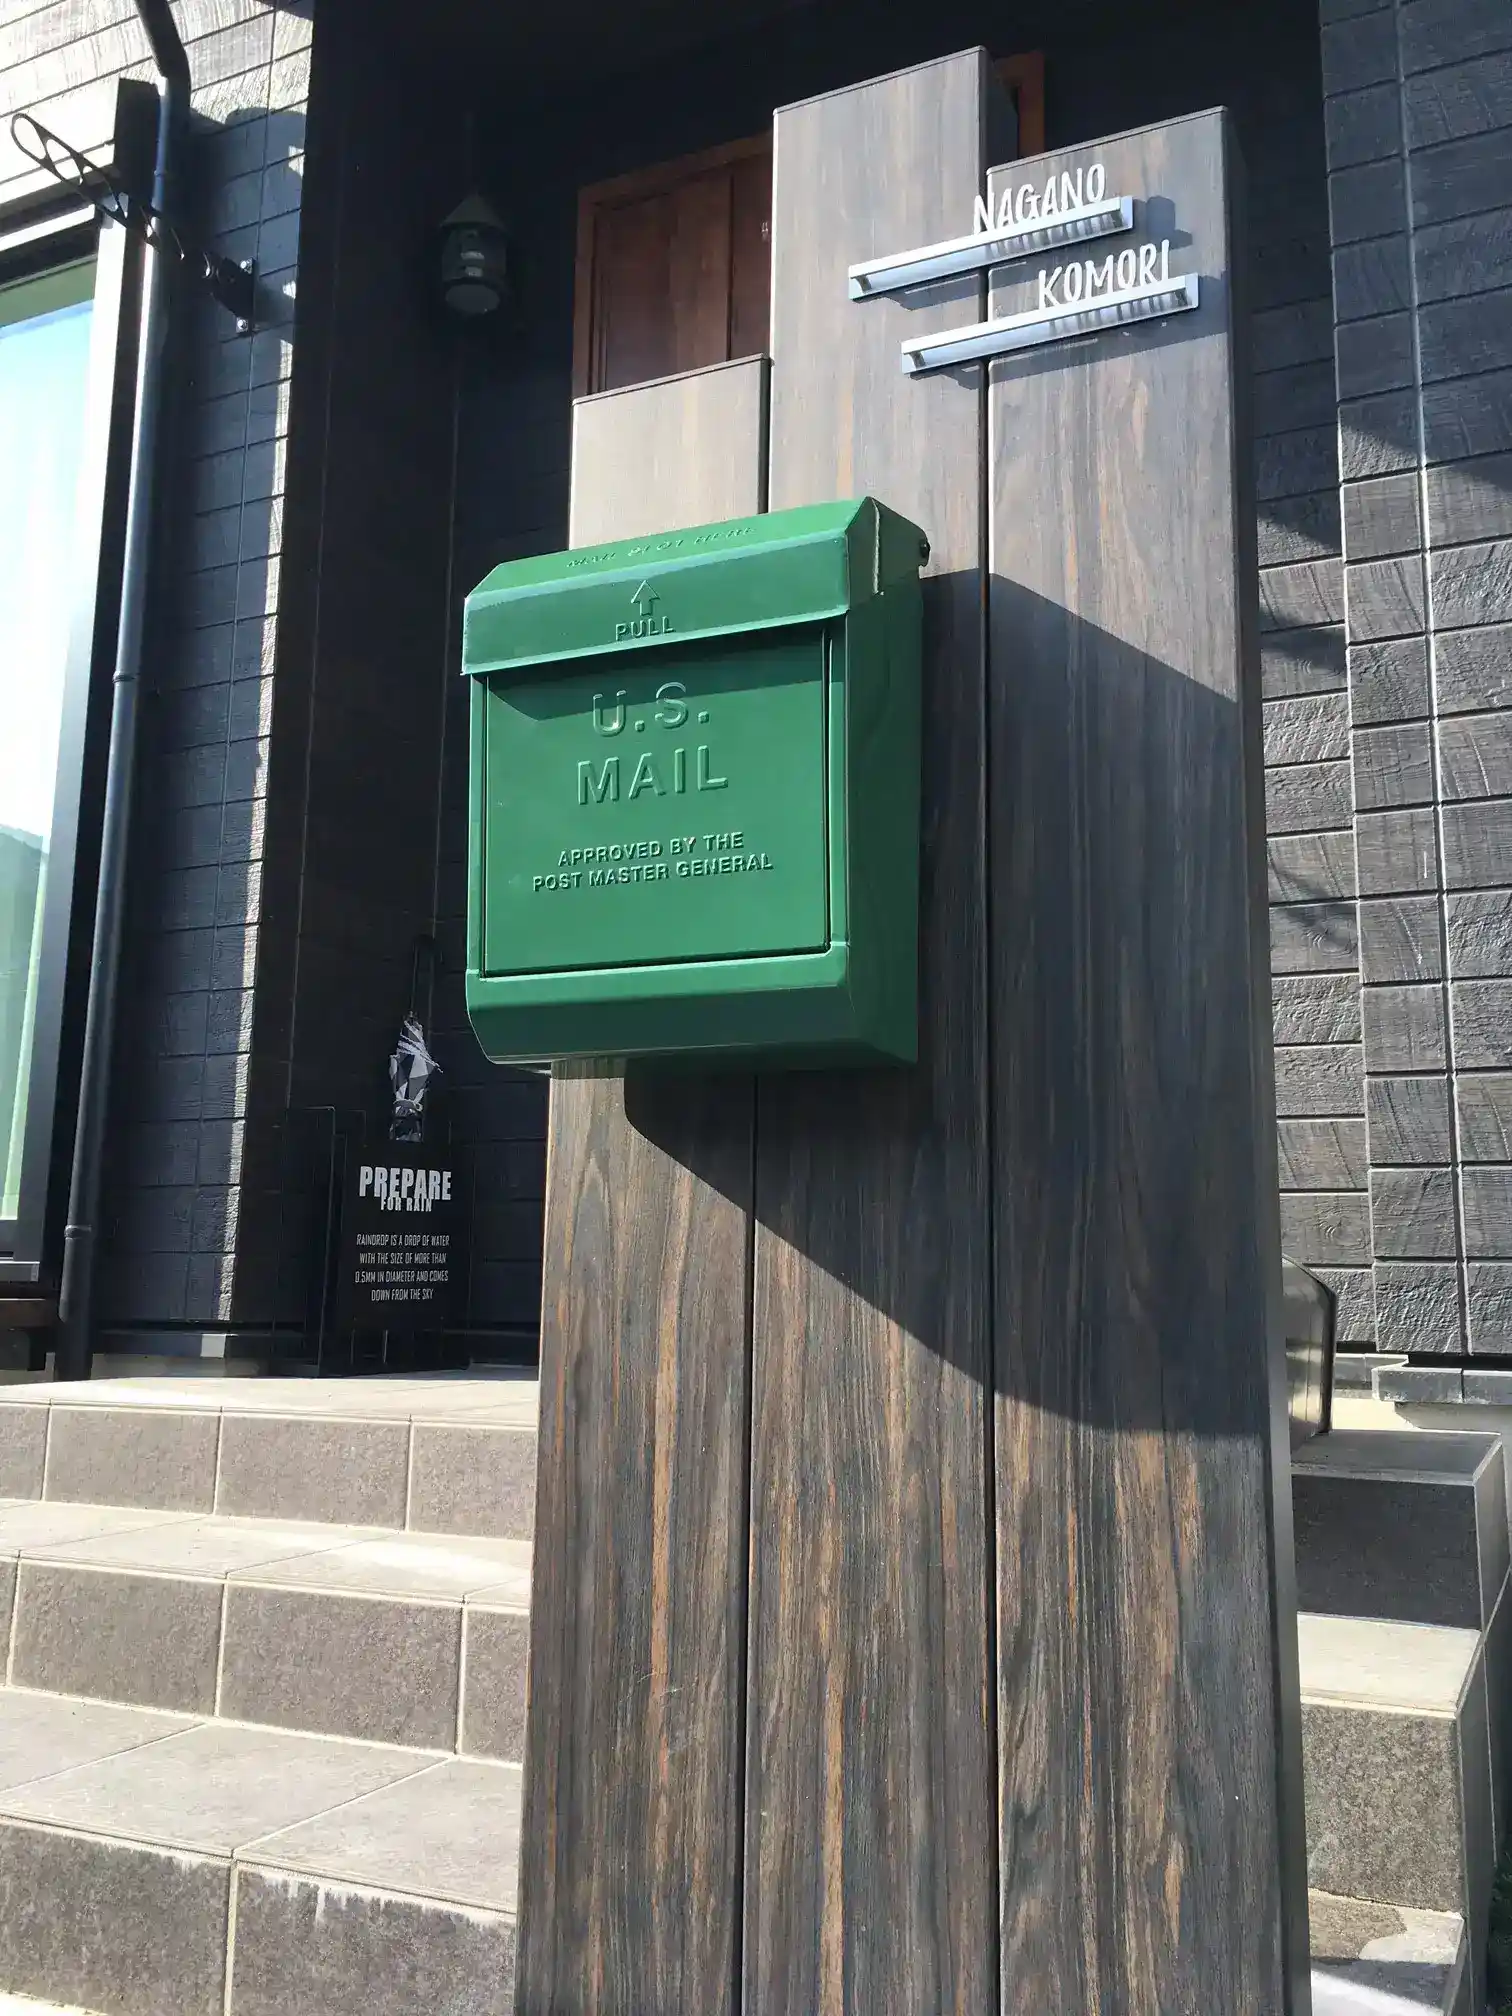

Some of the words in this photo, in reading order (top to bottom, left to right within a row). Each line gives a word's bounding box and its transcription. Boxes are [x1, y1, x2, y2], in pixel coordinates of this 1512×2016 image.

[973, 163, 1106, 235] NAGANO
[1038, 239, 1170, 310] KOMORI
[615, 615, 675, 642] PULL
[592, 681, 710, 737] U.S.
[577, 745, 729, 805] MAIL
[557, 840, 663, 867] APPROVED
[669, 836, 697, 856] BY
[703, 831, 745, 851] THE
[532, 871, 583, 892] POST
[588, 863, 670, 887] MASTER
[675, 852, 774, 878] GENERAL
[359, 1165, 452, 1201] PREPARE
[381, 1196, 402, 1211] FOR
[406, 1197, 433, 1212] RAIN
[357, 1234, 389, 1246] RAINDROP
[391, 1235, 397, 1246] IS
[398, 1235, 403, 1246] A
[404, 1235, 421, 1246] DROP
[422, 1235, 430, 1246] OF
[431, 1235, 450, 1247] WATER
[360, 1253, 375, 1264] WITH
[377, 1253, 389, 1264] THE
[390, 1253, 403, 1264] SIZE
[405, 1253, 413, 1264] OF
[414, 1253, 430, 1264] MORE
[431, 1253, 447, 1264] THAN
[355, 1271, 376, 1283] 0.5MM
[377, 1271, 385, 1282] IN
[386, 1271, 415, 1282] DIAMETER
[416, 1271, 429, 1282] AND
[429, 1271, 449, 1282] COMES
[371, 1289, 390, 1302] DOWN
[391, 1289, 408, 1301] FROM
[410, 1289, 421, 1300] THE
[422, 1288, 434, 1300] SKY
